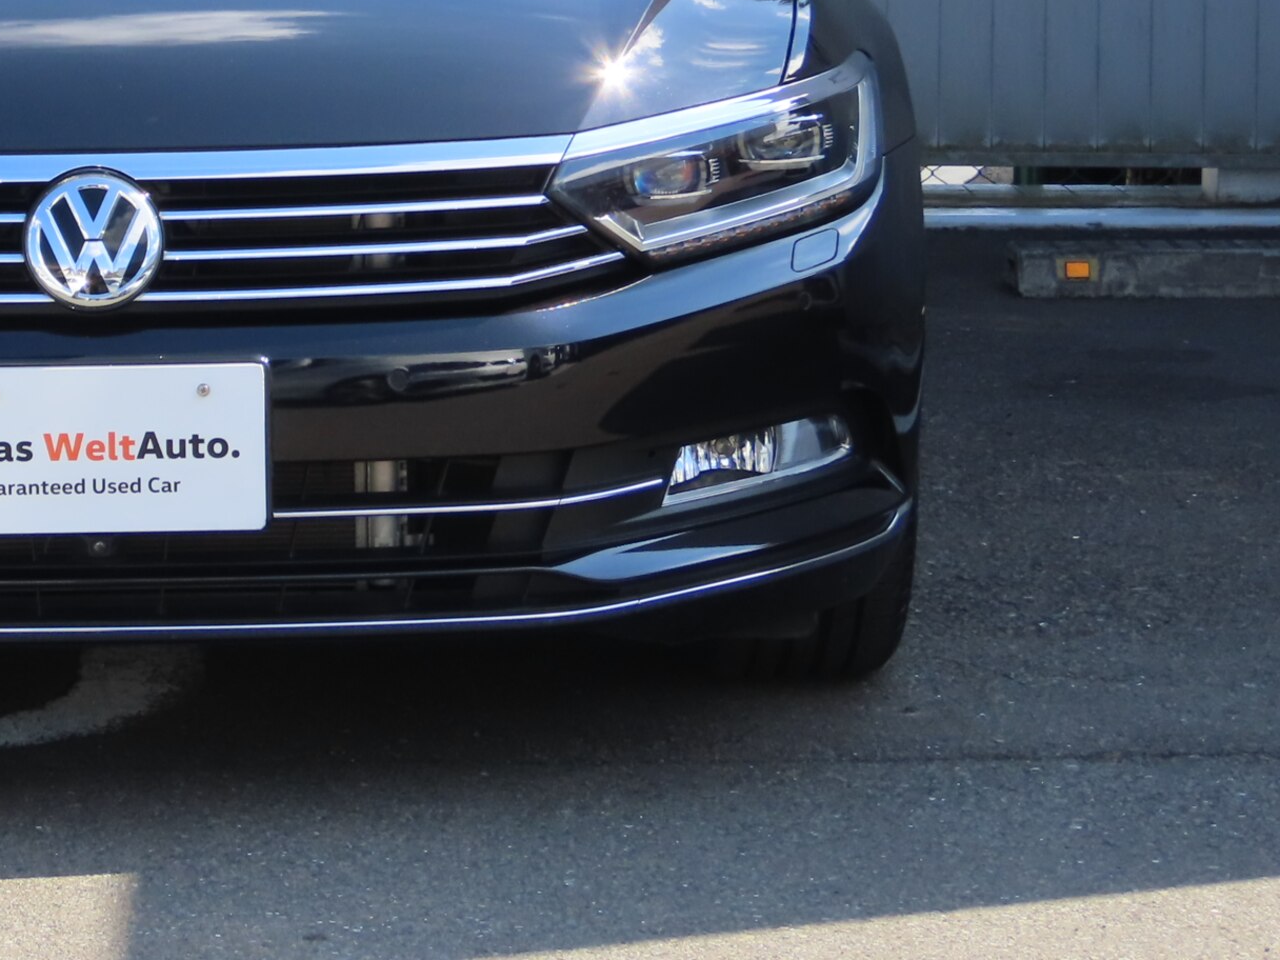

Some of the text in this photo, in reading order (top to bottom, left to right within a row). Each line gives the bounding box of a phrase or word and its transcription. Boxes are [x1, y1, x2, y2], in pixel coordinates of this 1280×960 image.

[43, 431, 240, 461] WeltAuto.
[92, 477, 142, 495] Used
[147, 476, 181, 494] Car
